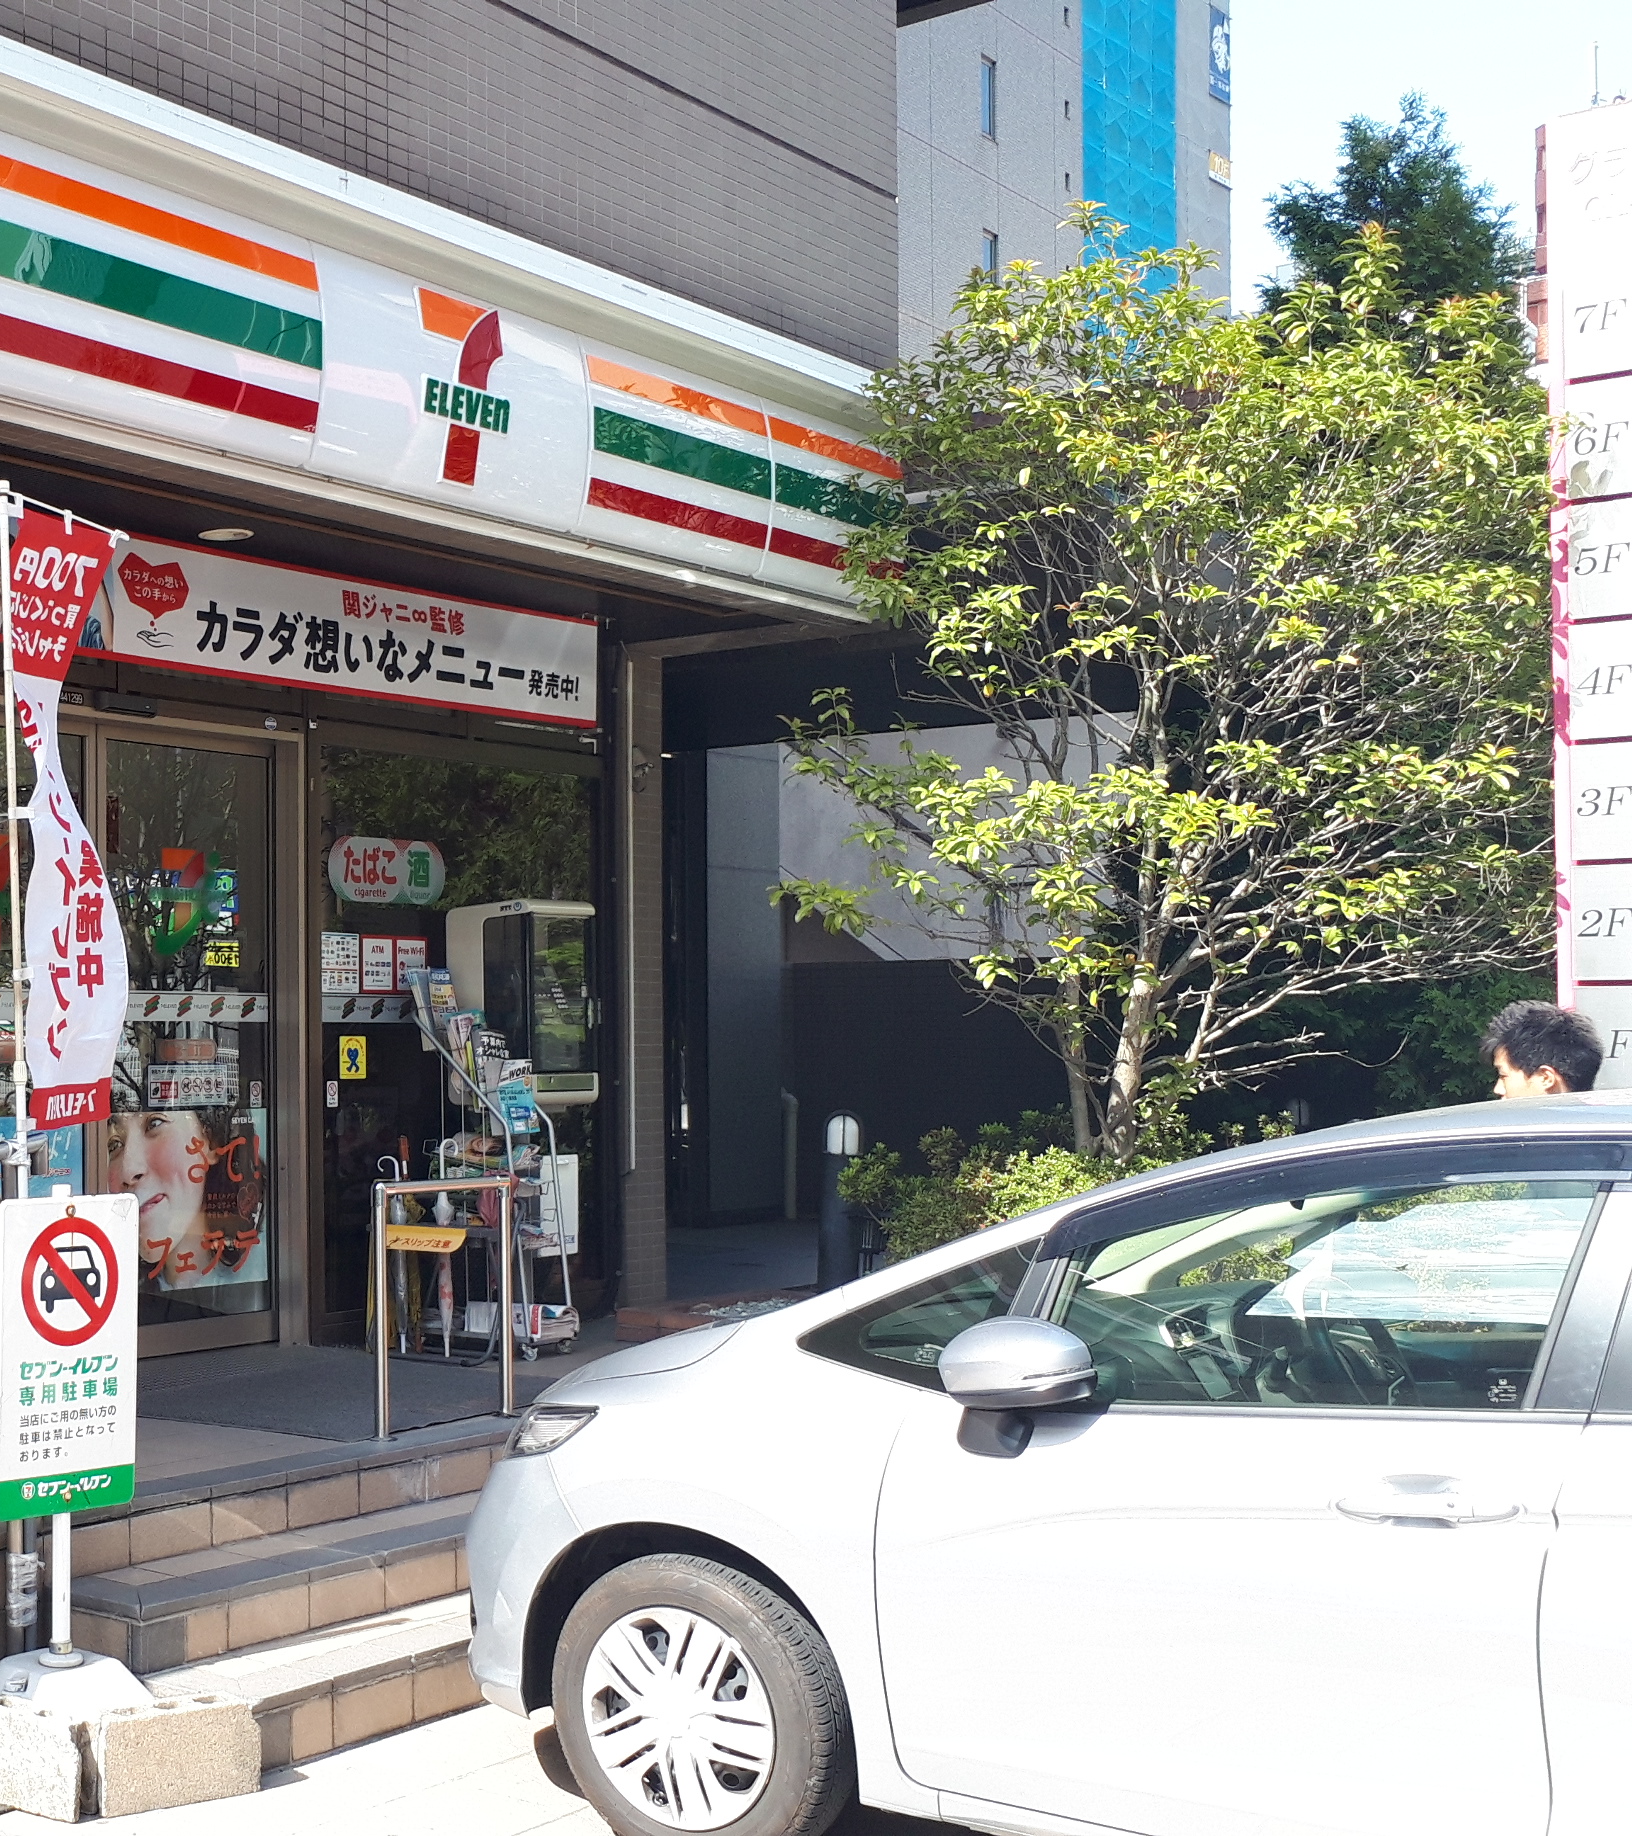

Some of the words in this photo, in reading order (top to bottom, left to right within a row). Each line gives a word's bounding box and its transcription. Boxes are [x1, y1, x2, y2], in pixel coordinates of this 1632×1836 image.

[1573, 298, 1627, 334] 7F
[1573, 420, 1629, 457] 6F
[1573, 543, 1630, 577] 5F
[123, 568, 184, 589] カラダへの想い
[134, 585, 176, 604] この手から
[1577, 664, 1632, 697] 4F
[1577, 786, 1632, 818] 3F
[343, 845, 398, 886] たばこ
[406, 849, 431, 888] 酒
[354, 886, 387, 899] cigarette
[1577, 908, 1632, 939] 2F
[370, 945, 385, 954] ATM
[509, 1064, 532, 1079] WORK
[402, 1237, 452, 1250] スリップ注意
[18, 1377, 119, 1407] 専用駐車場
[19, 1404, 117, 1428] 当店にご用の無い方の
[19, 1422, 116, 1446] 駐車は禁止となって
[19, 1446, 69, 1463] おります。
